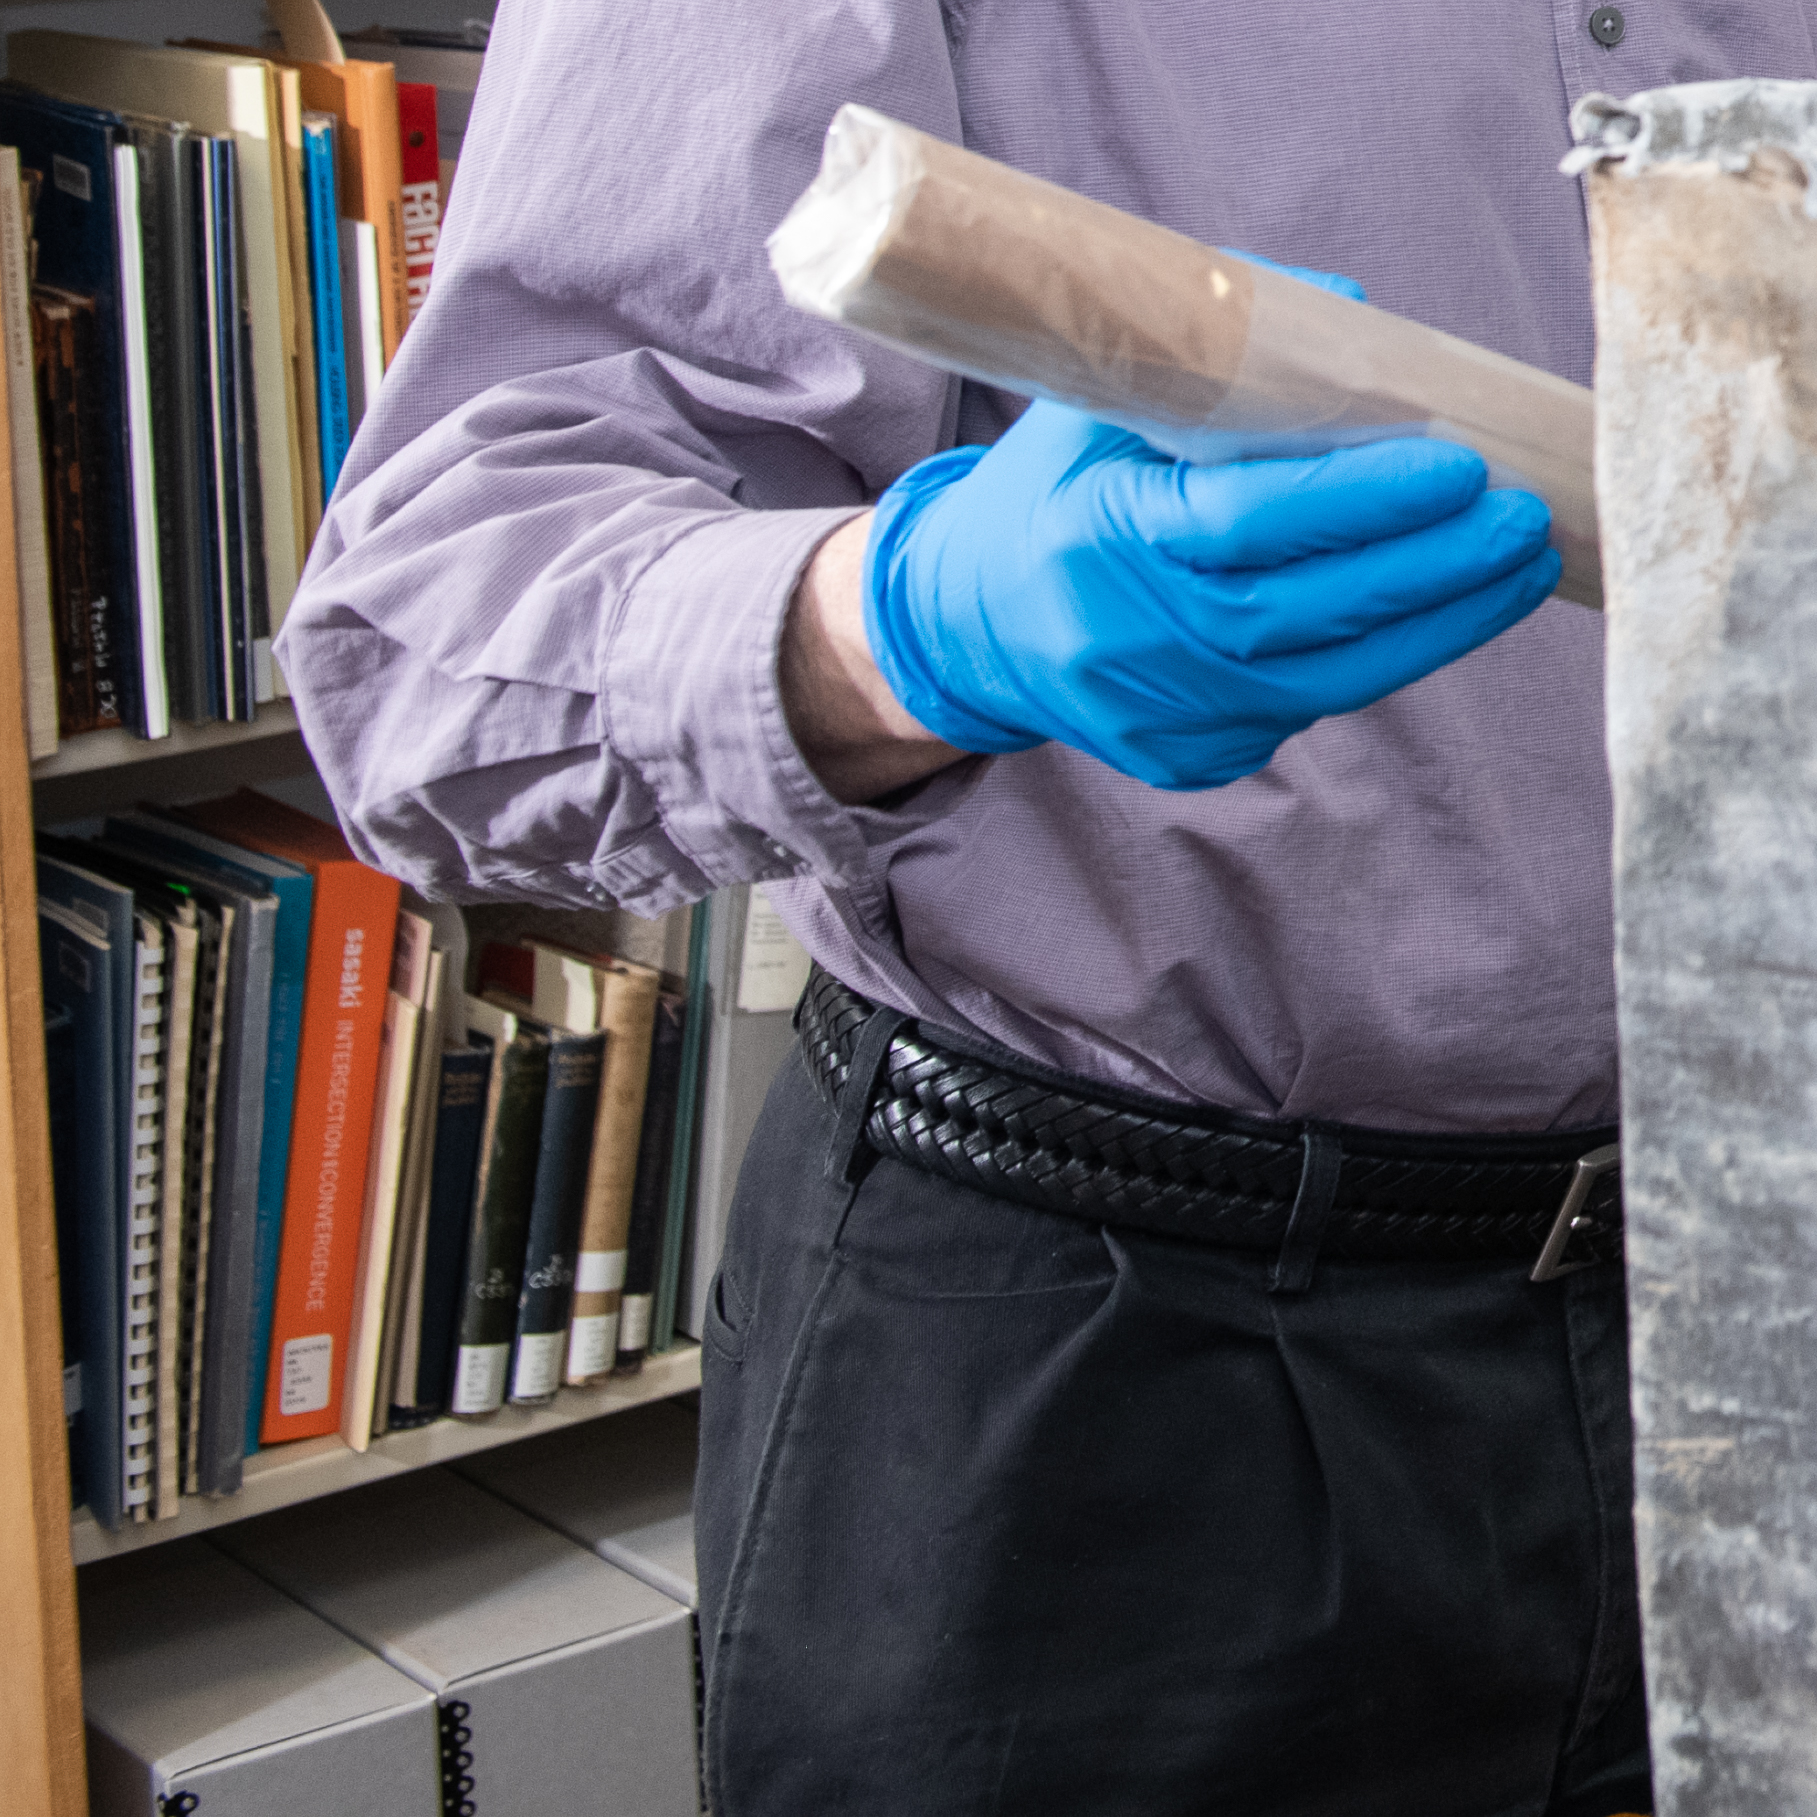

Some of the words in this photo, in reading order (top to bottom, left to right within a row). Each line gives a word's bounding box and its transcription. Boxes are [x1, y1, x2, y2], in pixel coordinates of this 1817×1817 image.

[338, 928, 364, 1009] sasaki
[322, 1019, 354, 1159] INTERSECTION
[306, 1169, 341, 1312] CONVERGENCE
